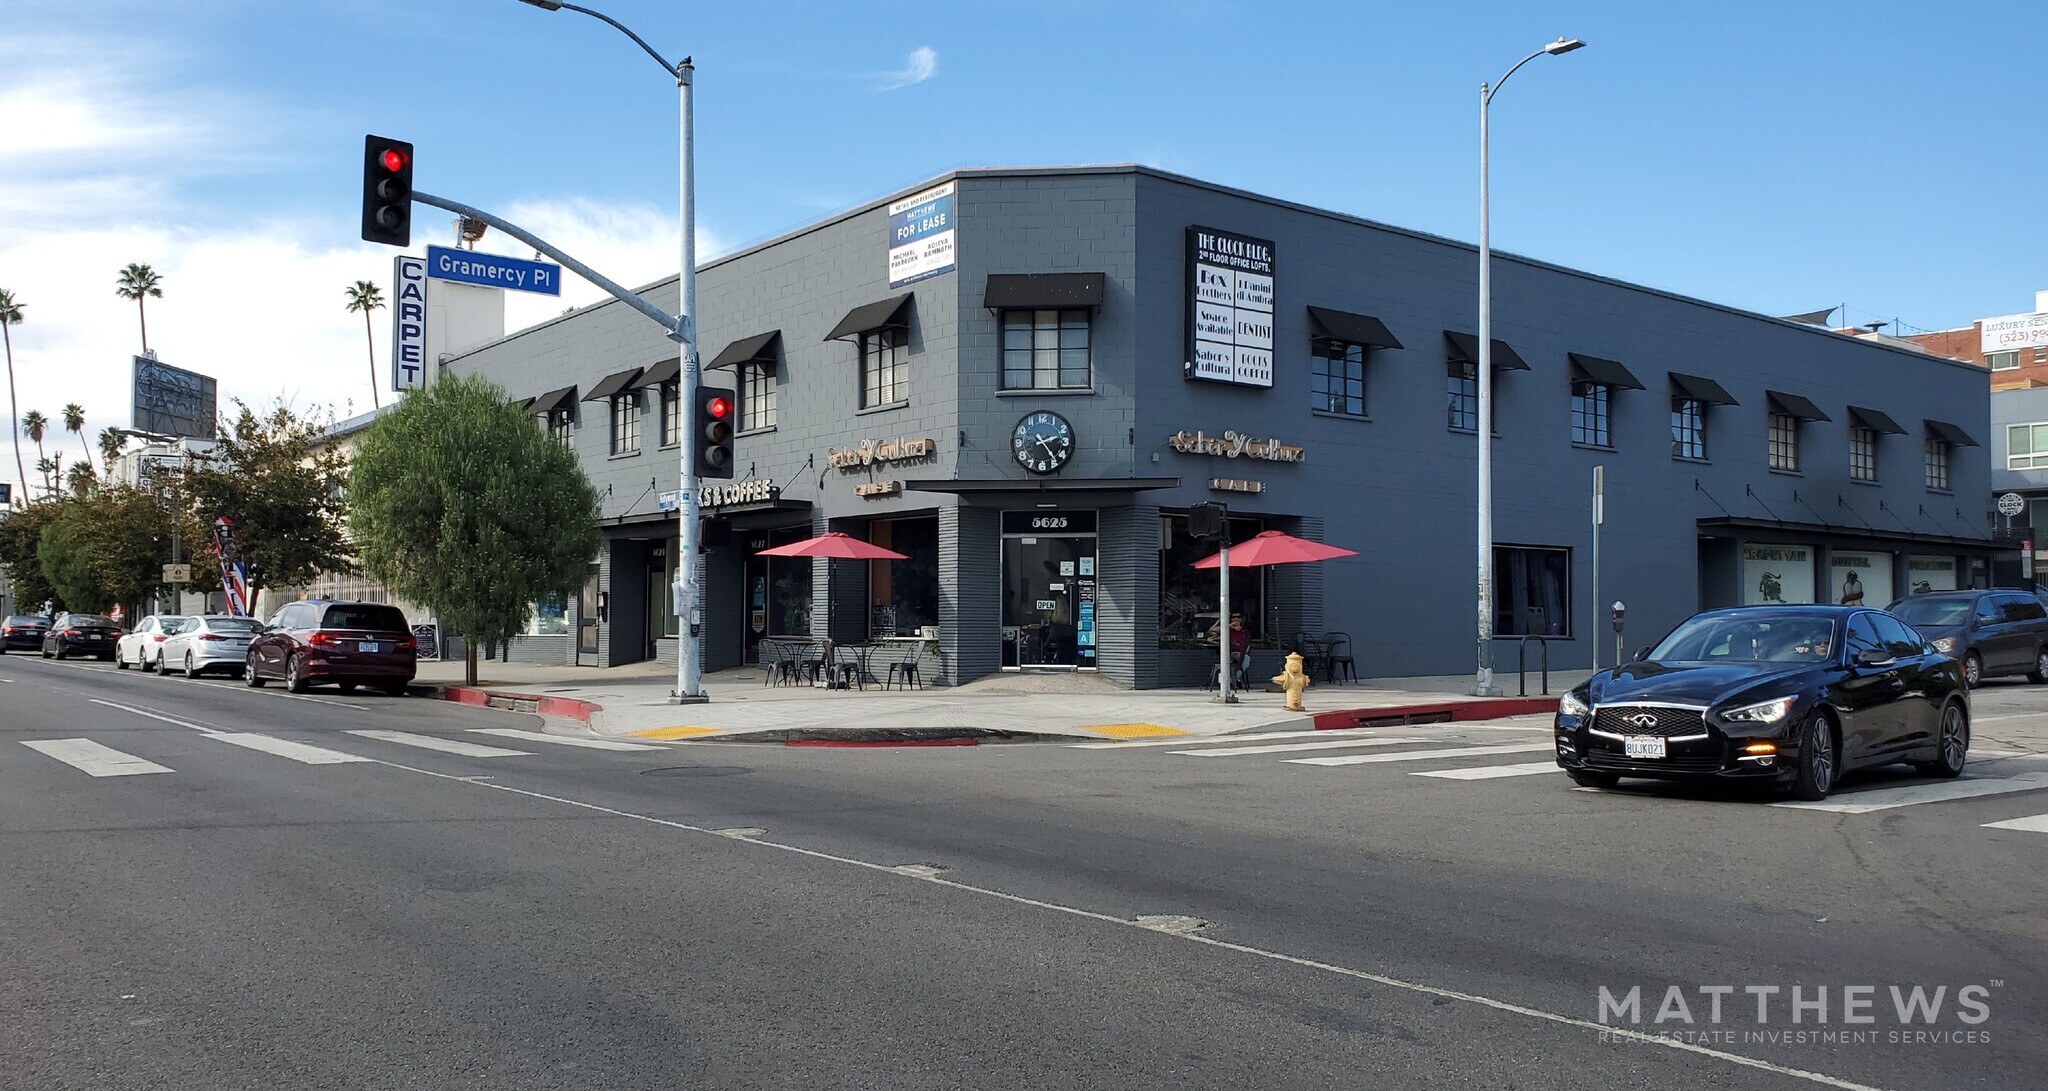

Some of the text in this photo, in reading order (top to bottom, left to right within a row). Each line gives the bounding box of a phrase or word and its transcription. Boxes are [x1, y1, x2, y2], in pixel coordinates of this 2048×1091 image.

[895, 187, 948, 211] RETAIL AND RESTAURANT
[897, 213, 946, 240] FOR LEASE
[1198, 233, 1271, 262] THE CLOCK BLDG.
[893, 249, 916, 260] MICHAEL
[1209, 252, 1229, 264] FLOOR
[1230, 256, 1250, 268] OFFICE
[1251, 261, 1271, 272] LOFTS.
[439, 255, 550, 287] Gramercy Pl
[1237, 291, 1273, 305] di Ambra
[401, 262, 423, 383] CARPET
[1201, 310, 1228, 324] Space
[1197, 322, 1233, 336] Available
[1238, 321, 1271, 339] DENTIST
[1986, 320, 2025, 332] LUXURY
[2000, 331, 2029, 344] (323)
[1195, 349, 1223, 362] Sabor
[1241, 354, 1268, 368] BOOKS
[1195, 361, 1231, 375] Cultura
[1237, 367, 1271, 380] COFFEE
[1028, 416, 1034, 426] 11
[1039, 414, 1048, 424] 12
[1052, 416, 1056, 426] 1
[1017, 425, 1026, 435] 10
[1060, 425, 1067, 434] 2
[1015, 438, 1022, 448] 9
[1062, 437, 1070, 447] 3
[1176, 430, 1226, 456] Sabor
[1245, 437, 1306, 462] Cultura
[1018, 451, 1026, 460] 8
[1058, 450, 1066, 459] 4
[1027, 459, 1034, 468] 7
[1038, 461, 1046, 471] 6
[1213, 478, 1266, 493] CAFE
[713, 486, 721, 506] &
[724, 480, 771, 504] COFFEE
[1032, 517, 1068, 528] 5625
[1038, 601, 1055, 610] OPEN
[1080, 634, 1089, 643] A
[1626, 743, 1664, 755] 8UJK021
